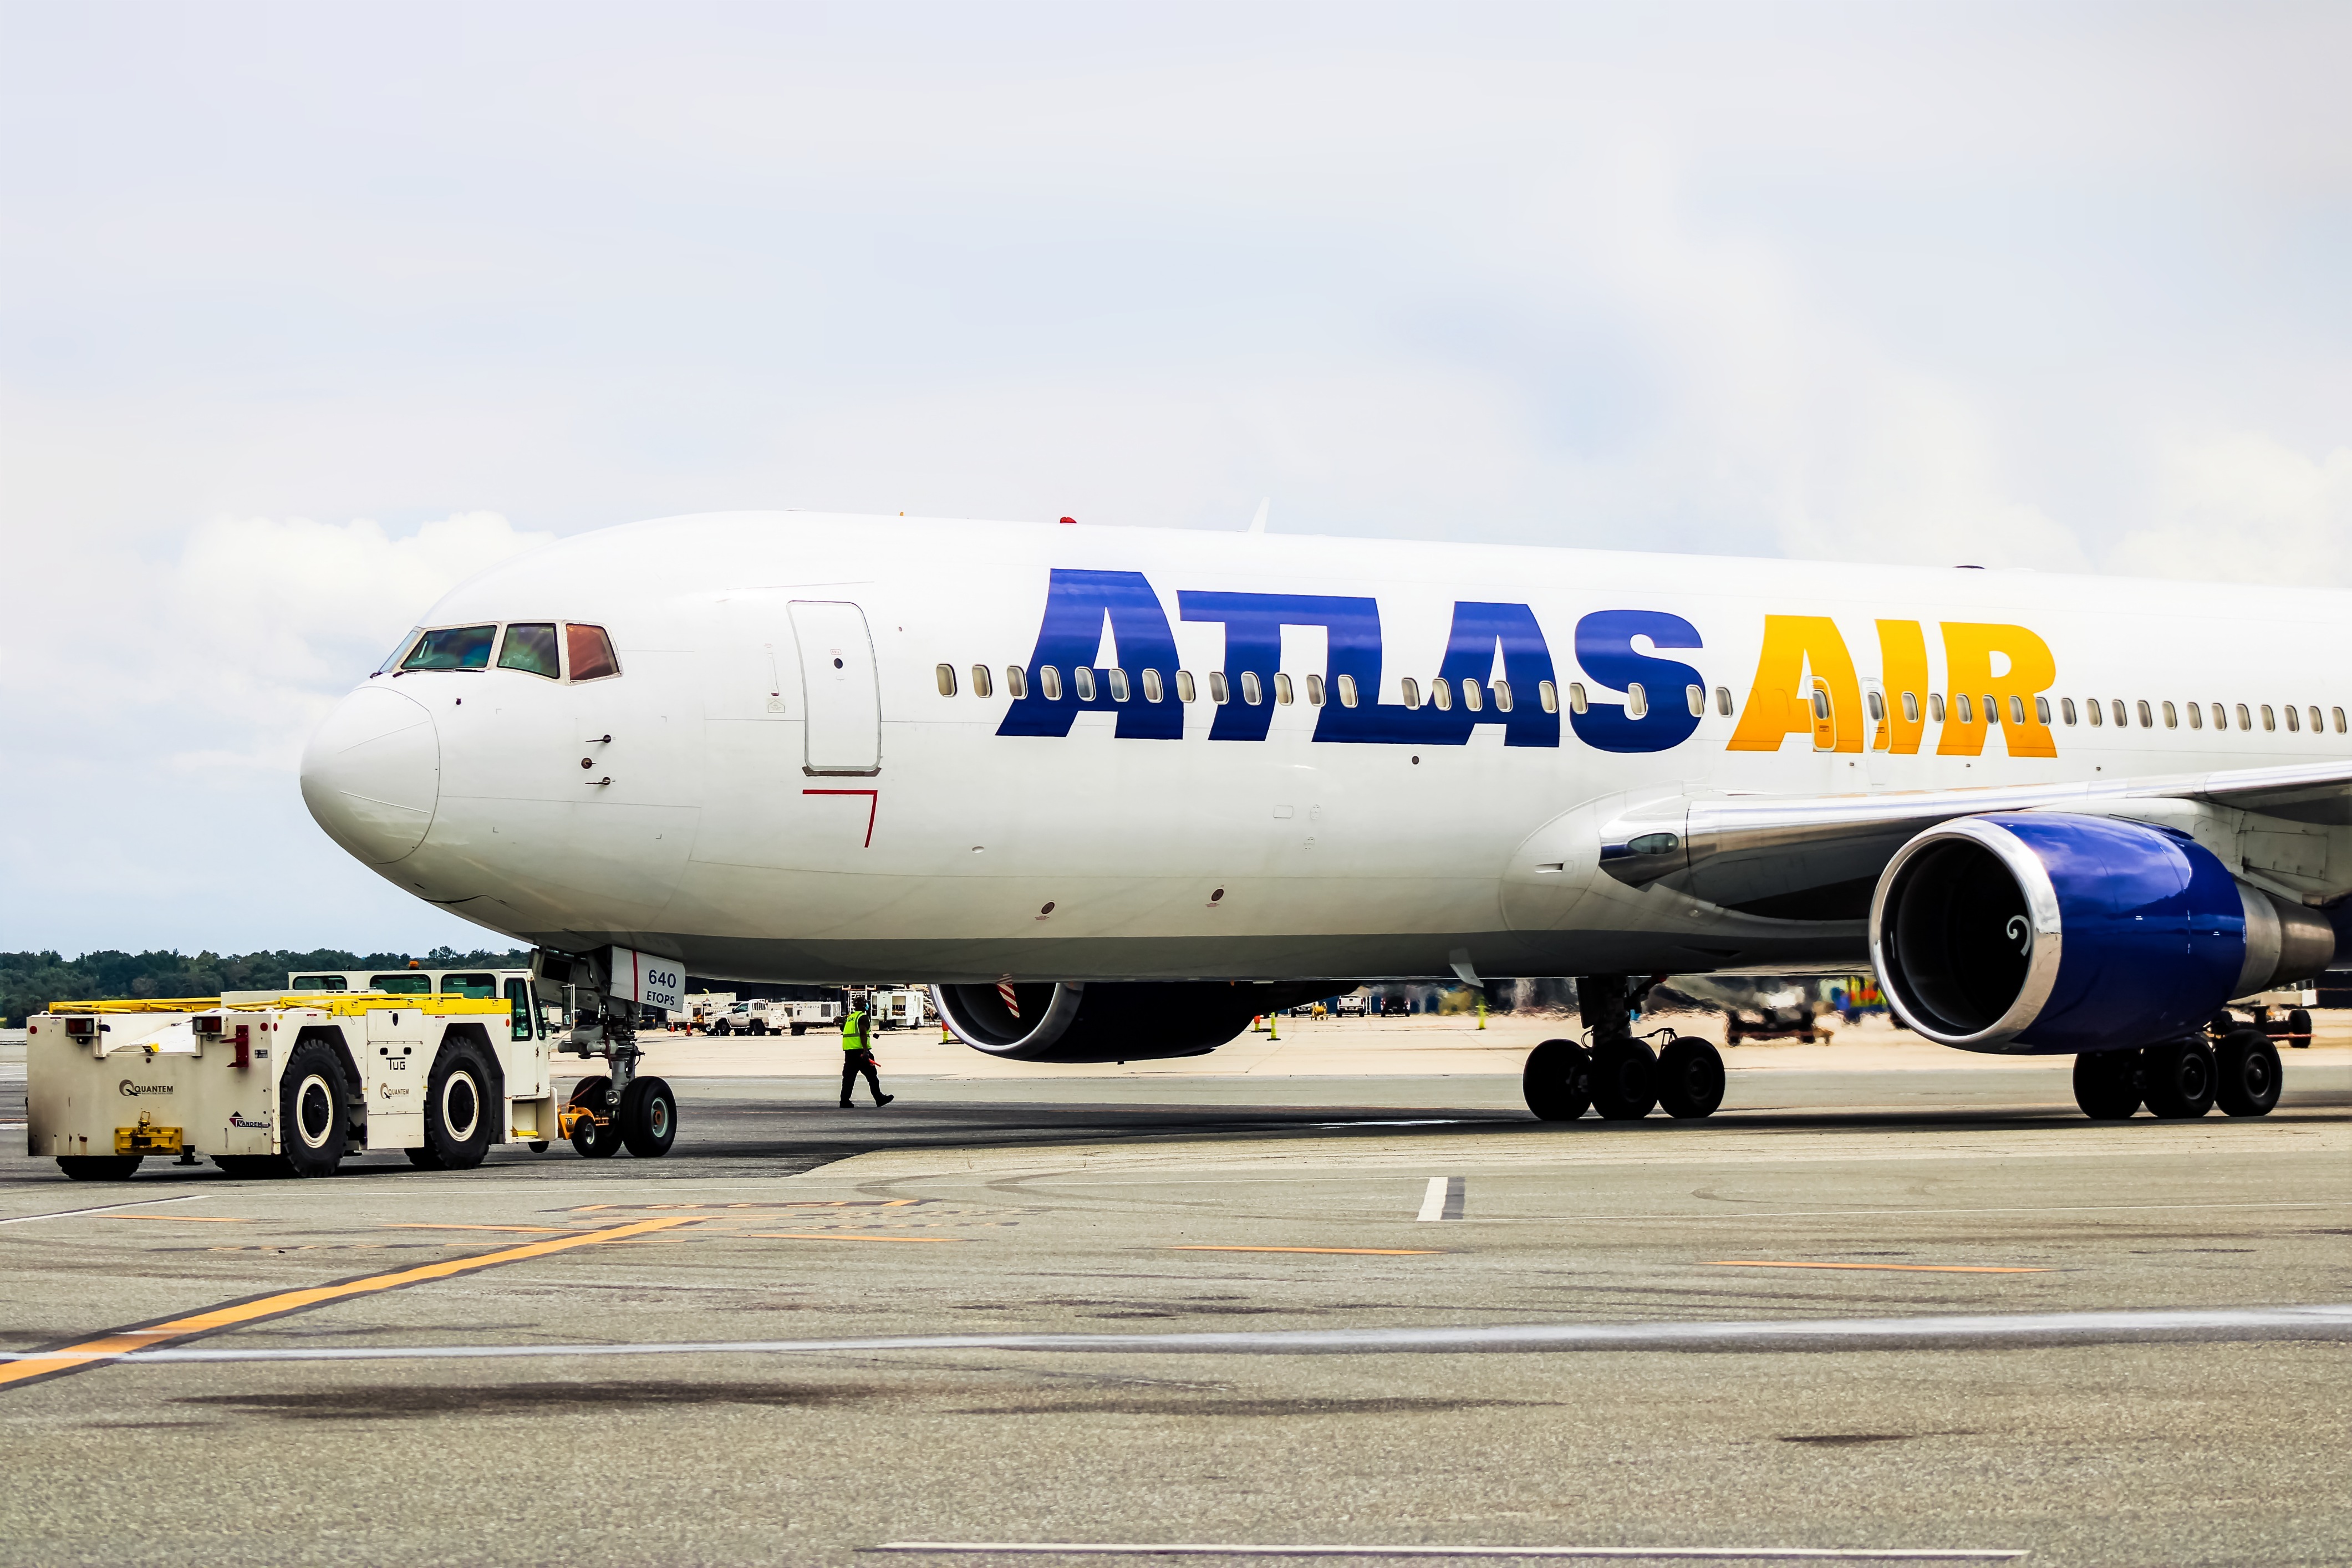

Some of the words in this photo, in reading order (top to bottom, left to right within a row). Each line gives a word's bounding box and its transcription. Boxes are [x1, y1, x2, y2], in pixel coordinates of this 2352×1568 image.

[995, 568, 1706, 753] ATLAS
[1725, 614, 2058, 758] AIR
[648, 969, 676, 989] 640
[646, 990, 675, 1006] ETOPS
[386, 1057, 405, 1070] TUG
